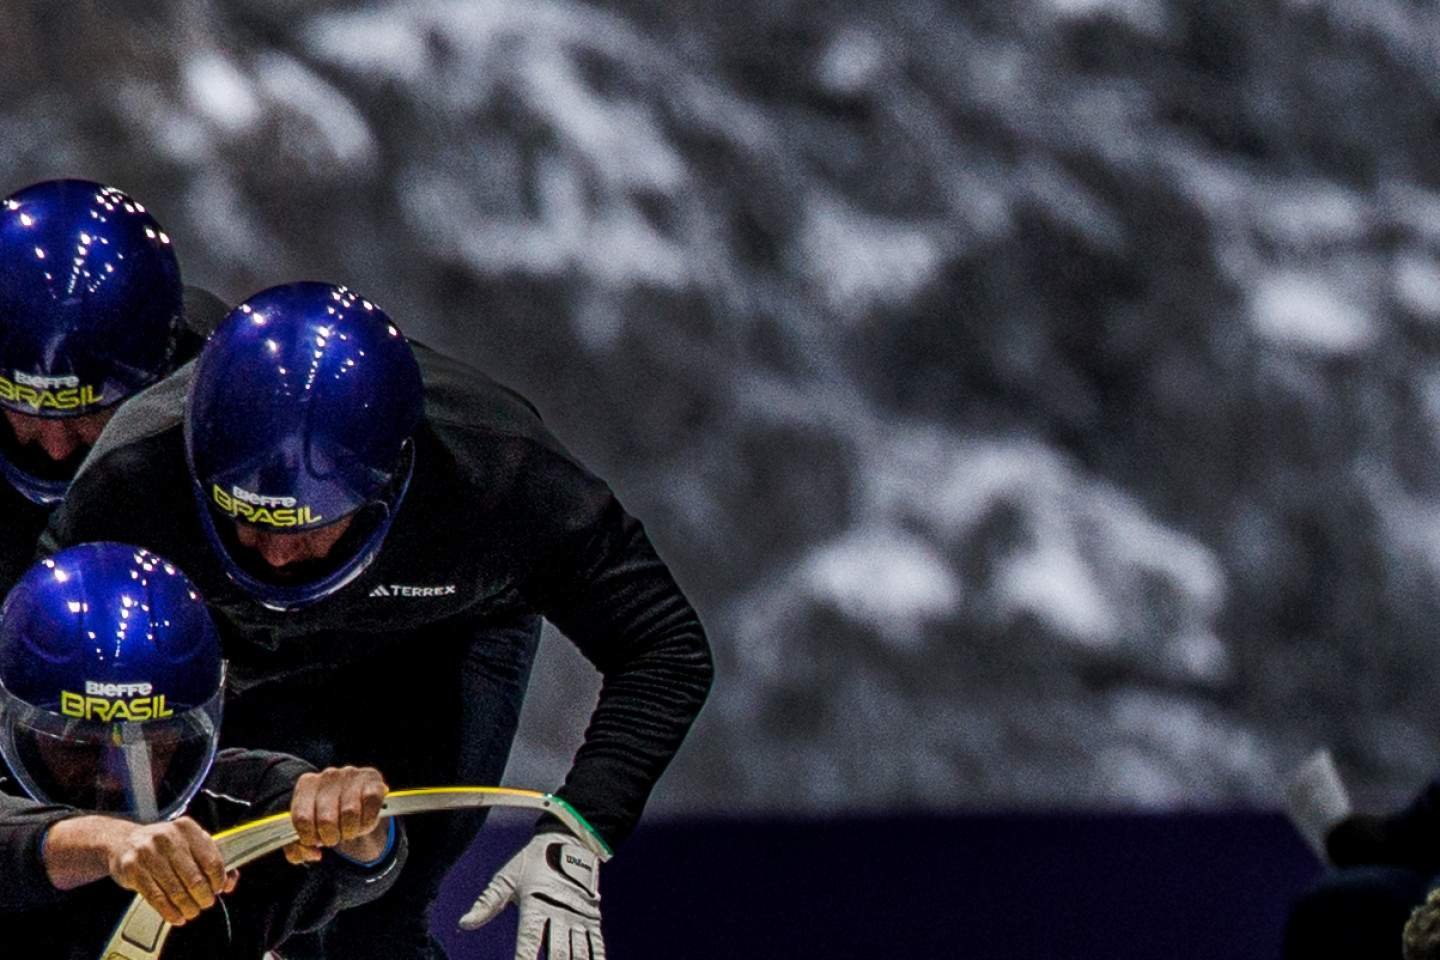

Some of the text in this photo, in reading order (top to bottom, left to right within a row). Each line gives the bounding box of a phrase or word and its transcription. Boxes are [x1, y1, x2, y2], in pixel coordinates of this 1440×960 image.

[213, 484, 322, 527] BRASIL
[390, 585, 456, 598] TERREX
[61, 690, 174, 722] BRASIL
